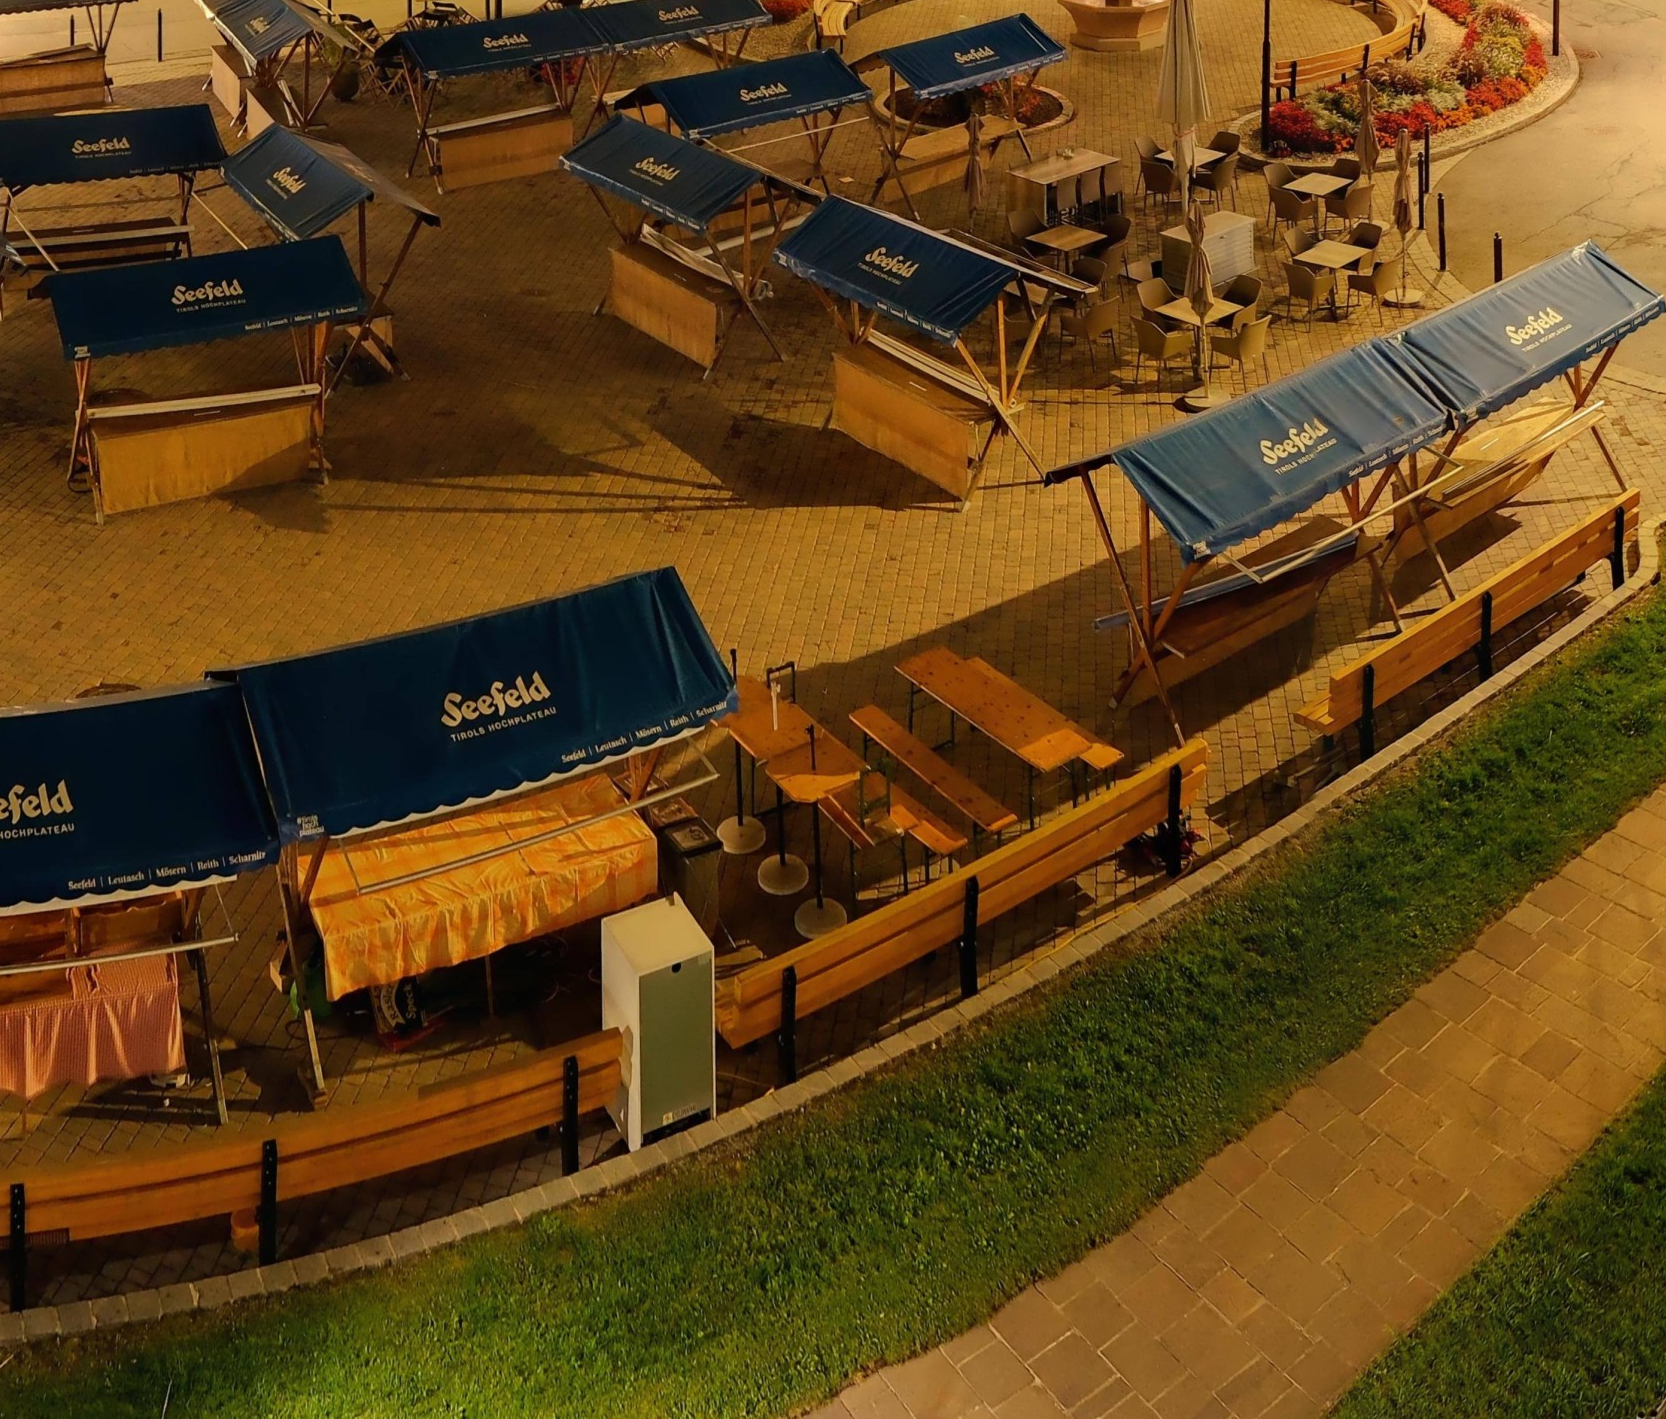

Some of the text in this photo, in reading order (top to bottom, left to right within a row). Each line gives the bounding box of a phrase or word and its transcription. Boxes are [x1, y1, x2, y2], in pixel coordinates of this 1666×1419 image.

[658, 5, 700, 21] Seefeld
[483, 33, 529, 49] Seefeld
[954, 45, 995, 64] Seefeld
[740, 82, 788, 102] Seefeld
[71, 137, 131, 154] Seefeld
[273, 167, 307, 194] Seefeld
[635, 157, 681, 180] Seefeld
[864, 246, 920, 278] Seefeld
[171, 279, 244, 306] Seefeld
[176, 299, 247, 313] TIROLS HOCHPLATEAU
[1505, 306, 1564, 346] Seefeld
[1259, 417, 1329, 466] Seefeld
[440, 671, 551, 728] Seefeld
[450, 706, 557, 743] TIROLS HOCHPLATEAU
[561, 748, 586, 763] Seefeld
[594, 737, 629, 756] Leutasch
[635, 726, 663, 742] Mösern
[669, 717, 690, 731] Reith
[68, 877, 97, 891] Seefeld
[107, 870, 144, 885] Leutasch
[156, 865, 187, 880] Mösern
[197, 859, 220, 873] Reith
[403, 983, 417, 1019] Speck
